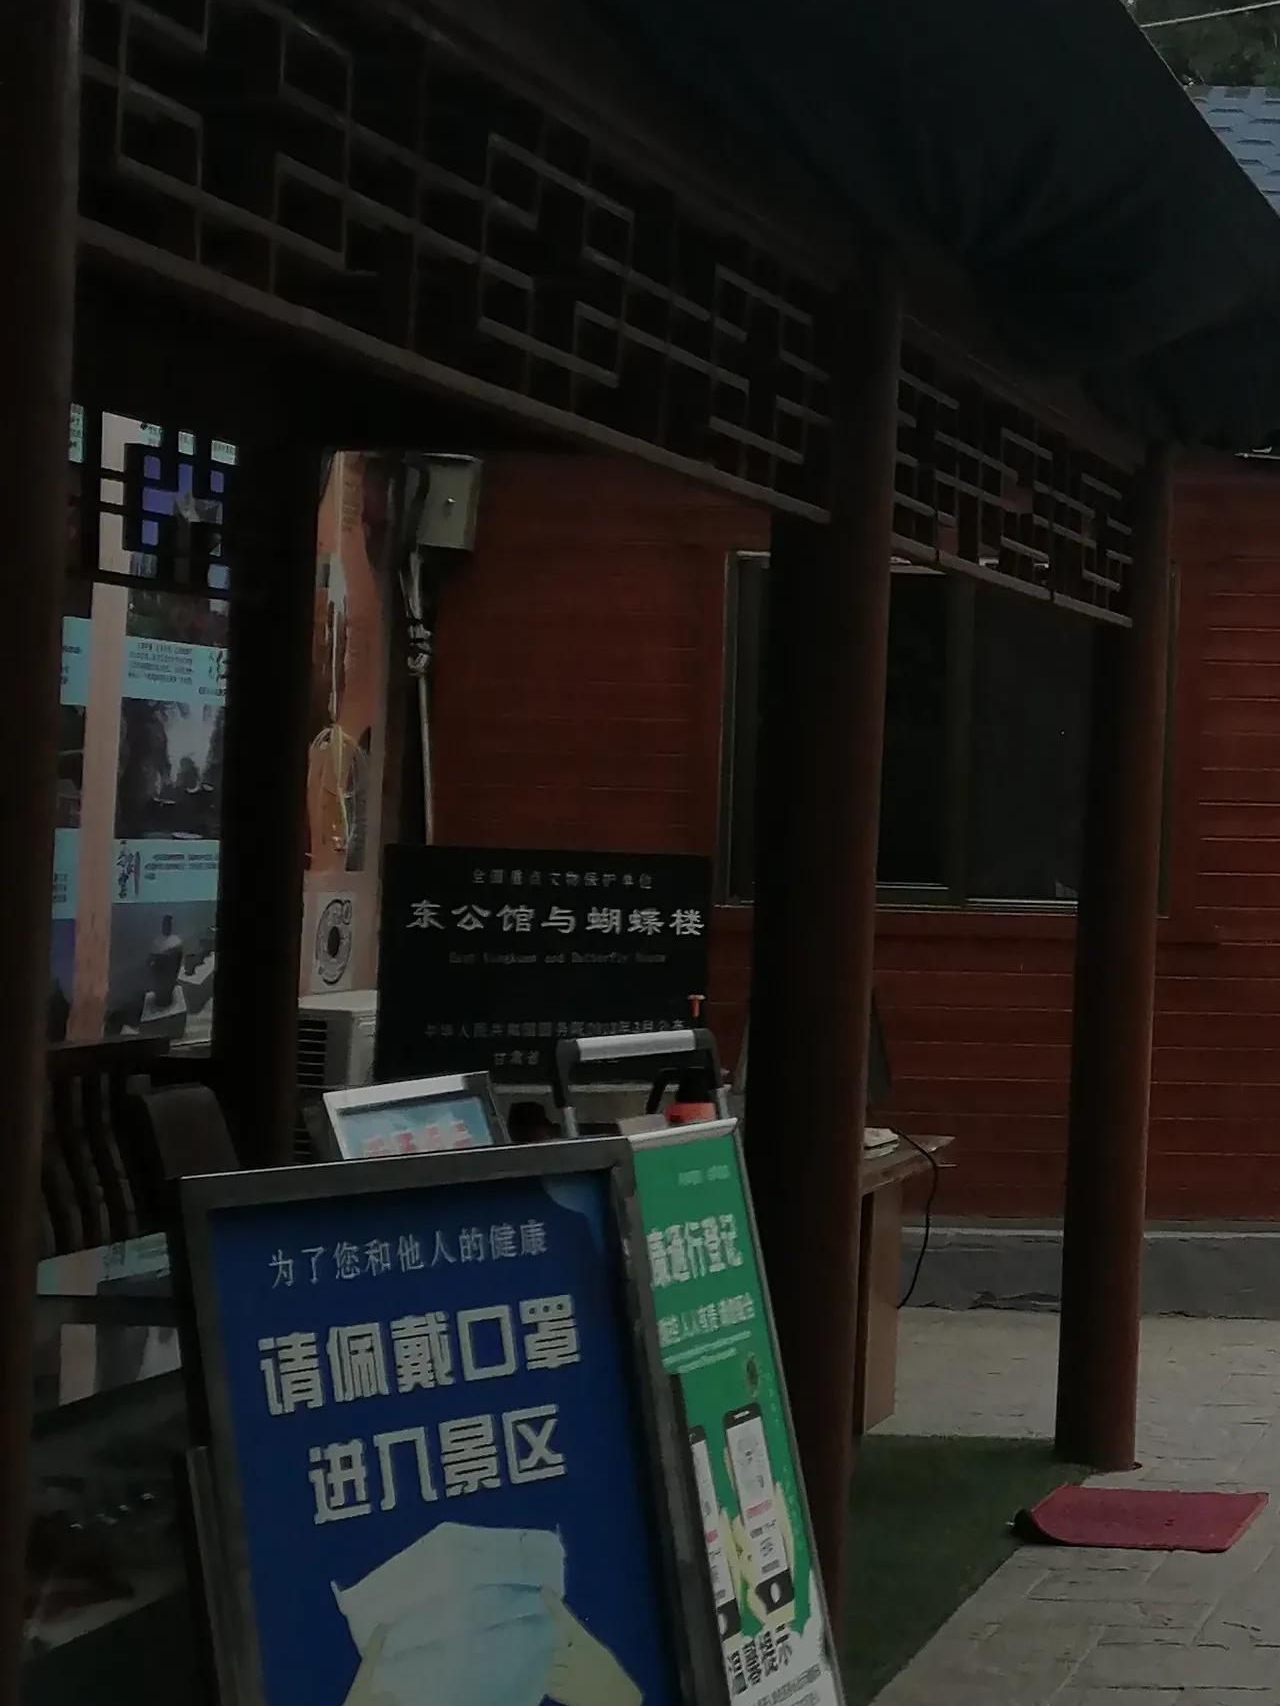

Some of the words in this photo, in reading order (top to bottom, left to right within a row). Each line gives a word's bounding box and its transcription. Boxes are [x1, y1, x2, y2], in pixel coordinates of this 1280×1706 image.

[404, 898, 707, 937] 东公馆与蝴蝶楼
[267, 1219, 549, 1290] 为了您和他人的健康
[257, 1293, 582, 1417] 请佩戴口罩
[307, 1403, 568, 1525] 进入景区
